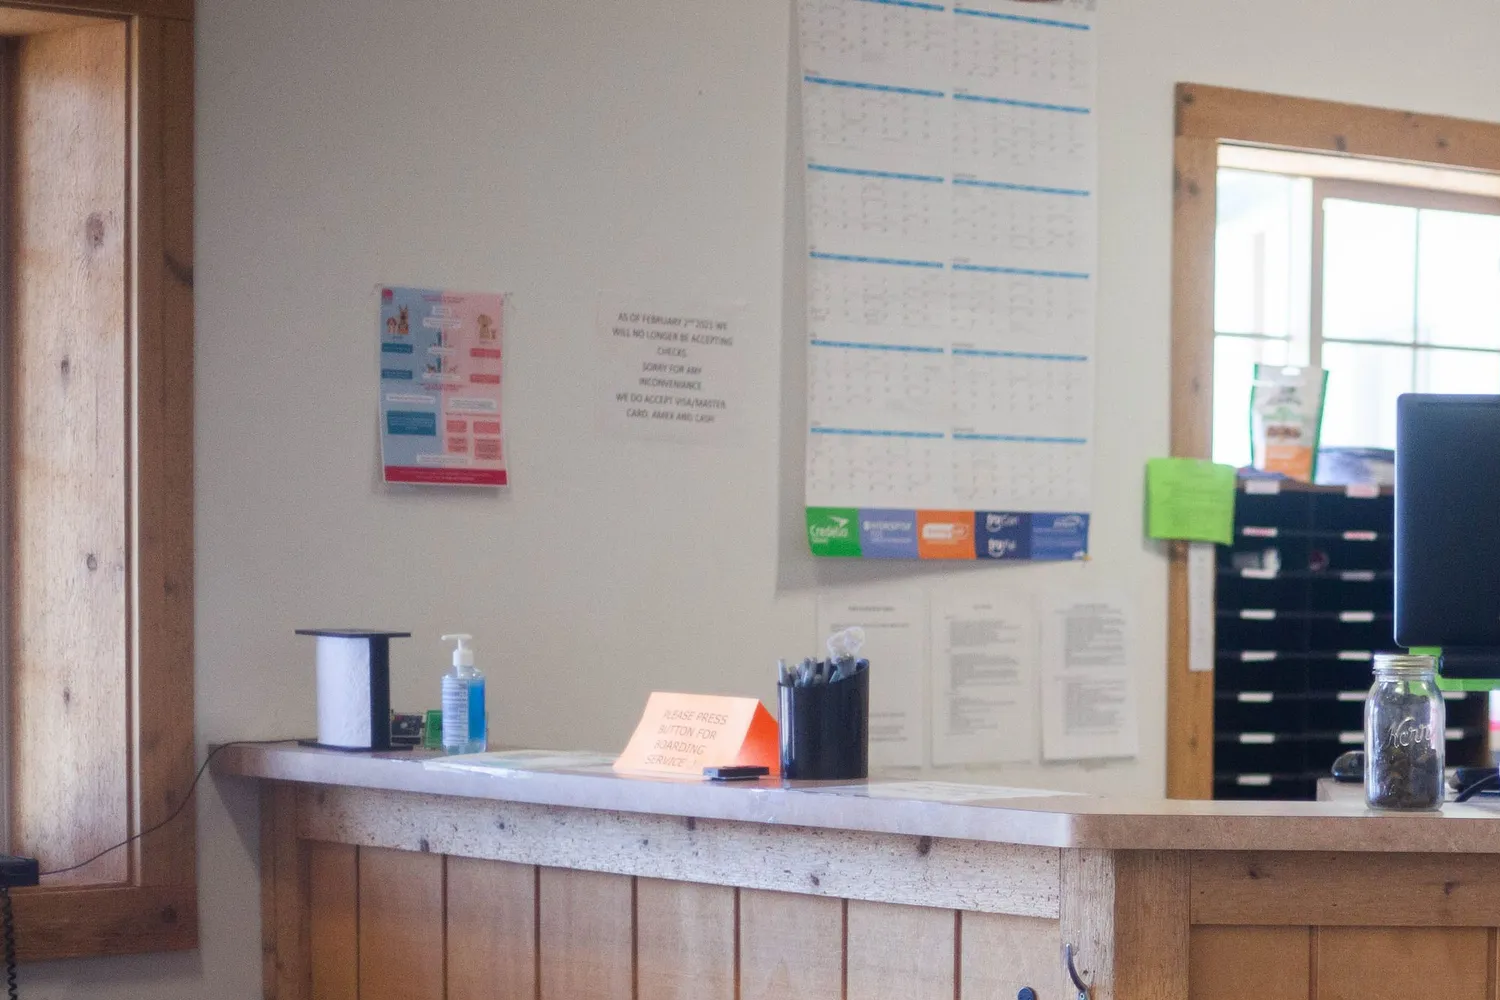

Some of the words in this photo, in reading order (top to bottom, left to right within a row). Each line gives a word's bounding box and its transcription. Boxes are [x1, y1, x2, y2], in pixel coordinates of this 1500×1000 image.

[612, 327, 630, 338] WILL
[633, 329, 645, 339] NO
[646, 330, 678, 341] LONGER
[691, 333, 733, 346] ACCEPTING
[663, 710, 695, 721] PLEASE
[696, 712, 729, 725] PRESS
[658, 724, 695, 738] BUTTON
[696, 728, 717, 740] FOR
[654, 740, 706, 756] BOARDING
[645, 754, 687, 768] SERVICE
